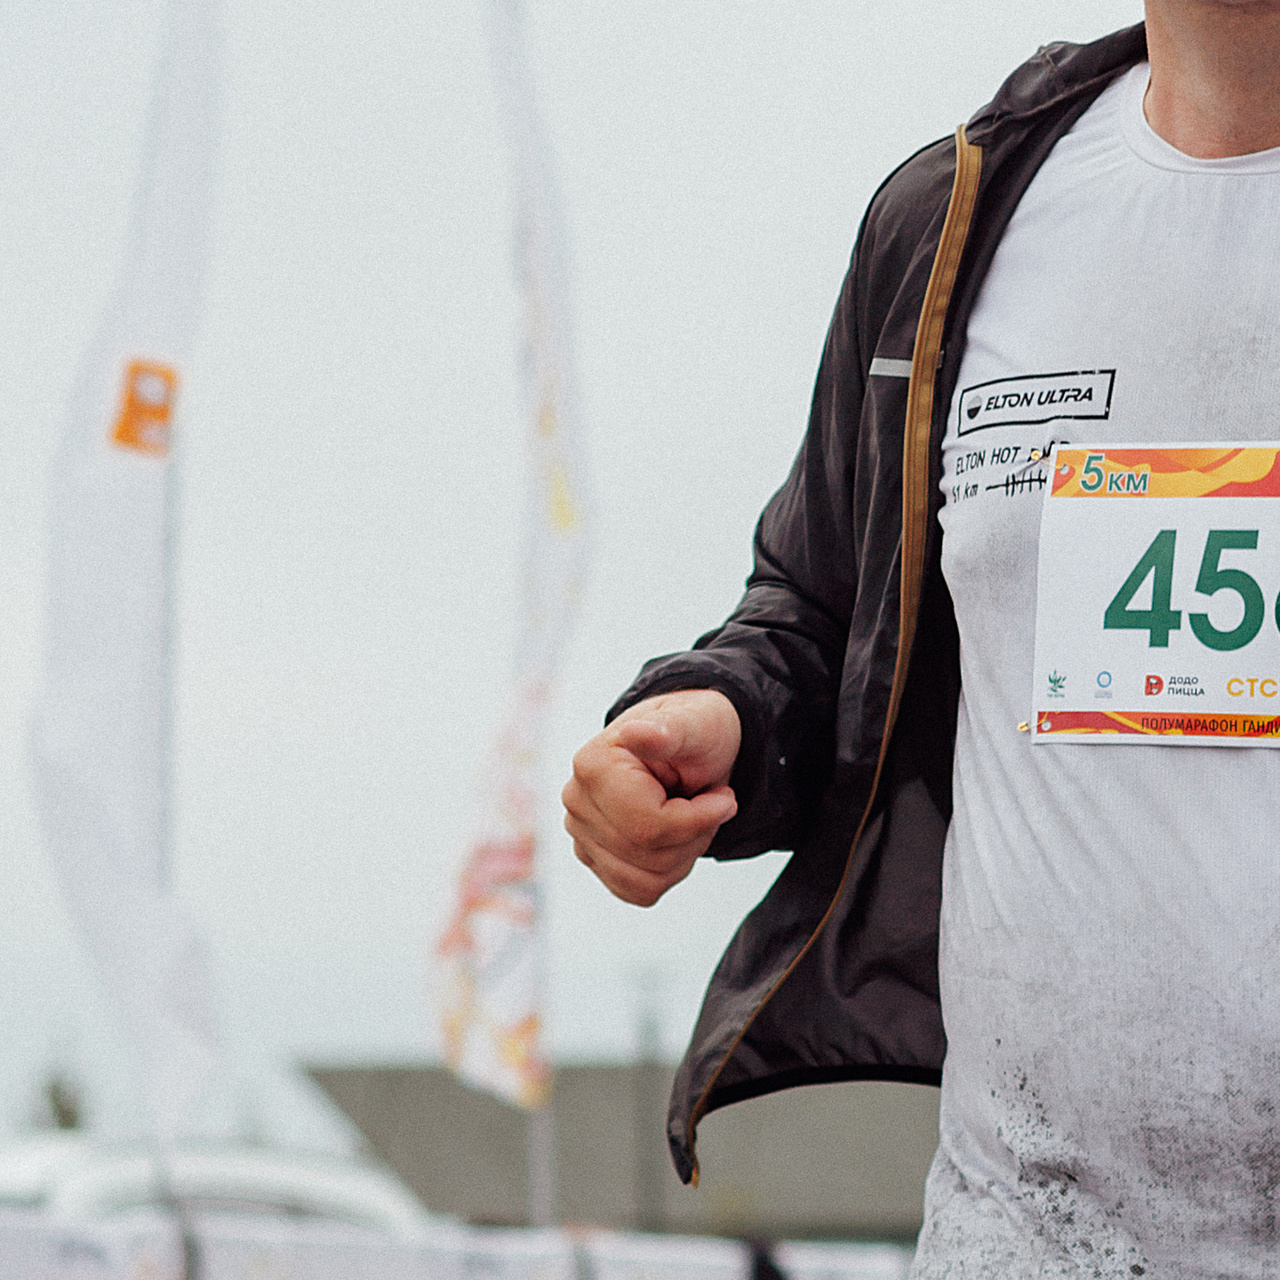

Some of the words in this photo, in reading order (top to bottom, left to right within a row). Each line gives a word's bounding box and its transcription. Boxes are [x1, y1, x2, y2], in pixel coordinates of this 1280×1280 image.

[985, 392, 1035, 411] ELTON
[1037, 387, 1094, 406] ULTRA
[956, 450, 986, 476] ELTON
[990, 446, 1022, 466] HOT
[1080, 454, 1104, 491] 5
[1168, 676, 1199, 686] ДОДО
[1167, 687, 1205, 696] ПИЦЦА
[1141, 717, 1239, 733] ПОЛУМАРАФОН
